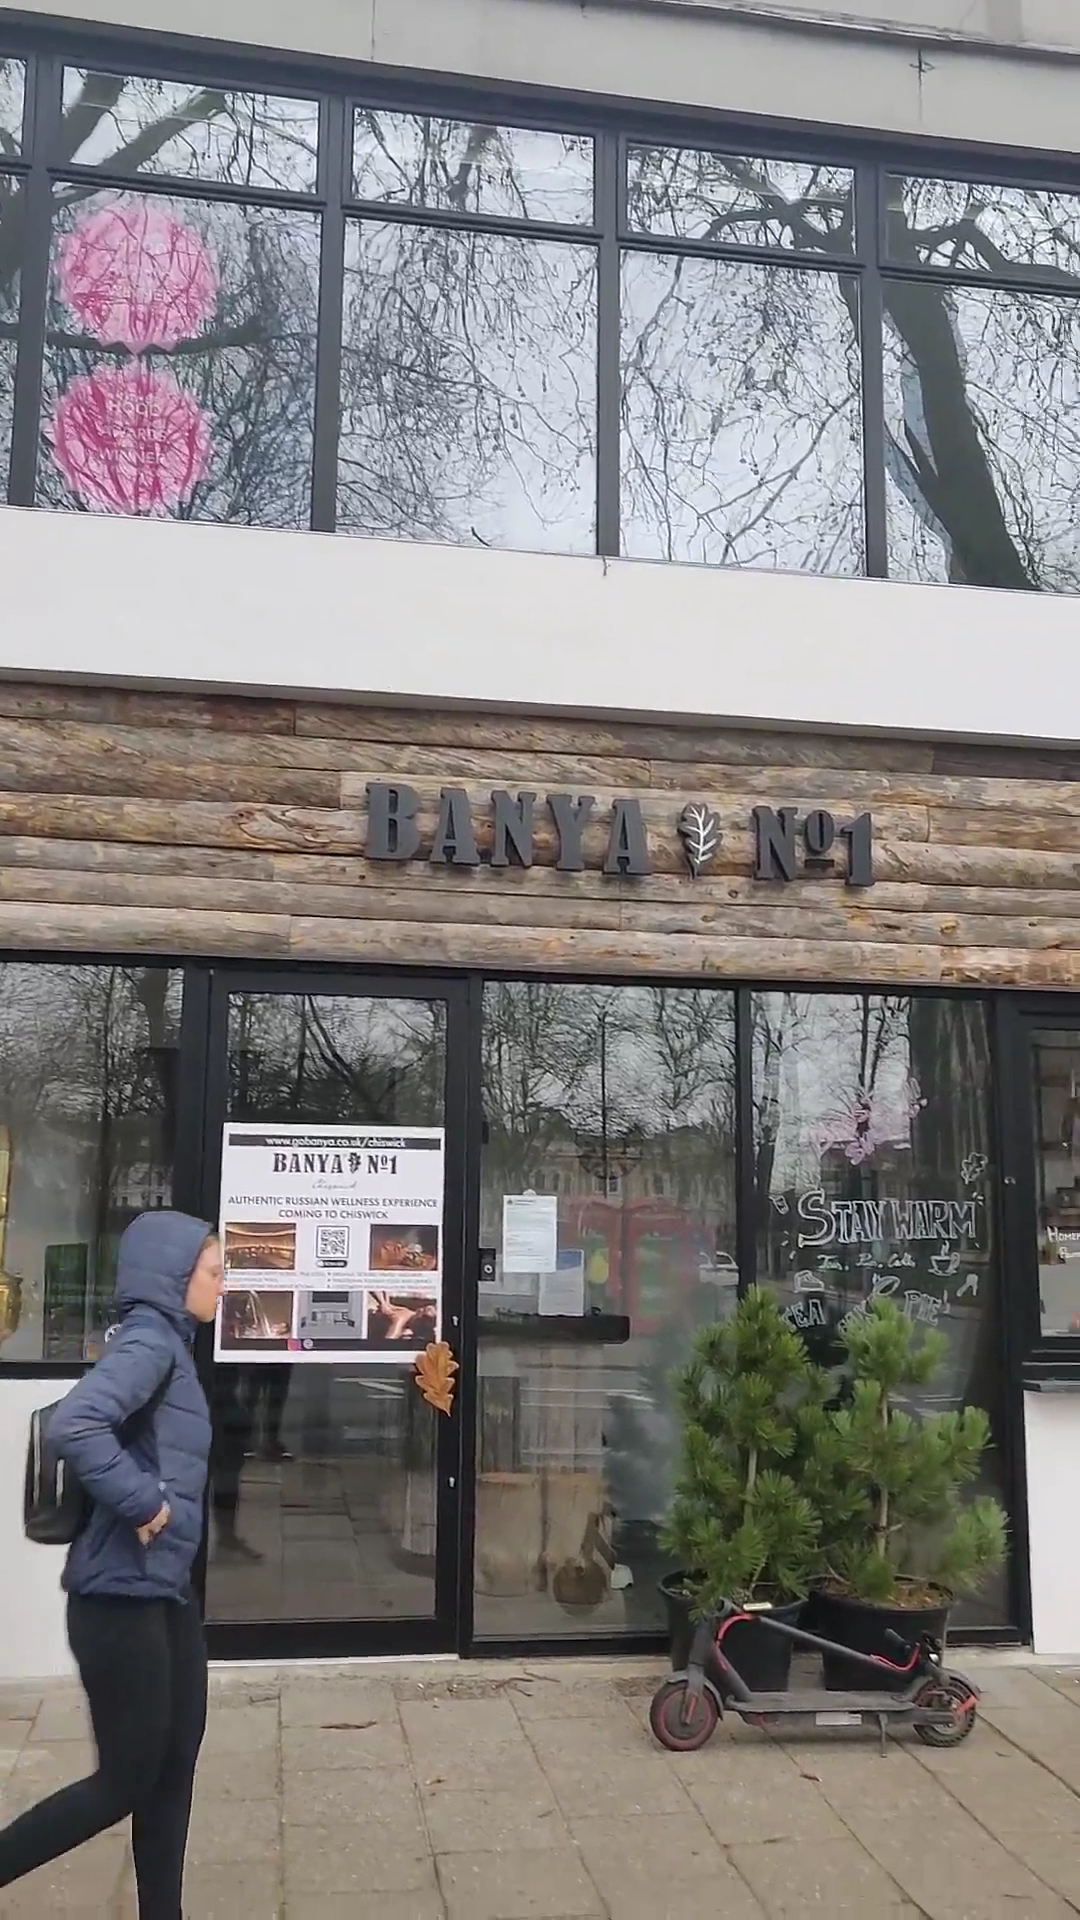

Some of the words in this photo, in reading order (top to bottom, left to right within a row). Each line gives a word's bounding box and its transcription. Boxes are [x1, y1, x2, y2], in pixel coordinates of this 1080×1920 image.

[365, 783, 652, 876] BANYA
[272, 1152, 344, 1174] BANYA
[228, 1196, 283, 1206] AUTHENTIC
[285, 1197, 329, 1206] RUSSIAN
[331, 1198, 380, 1207] WELLNESS
[382, 1198, 438, 1208] EXPERIENCE
[278, 1209, 322, 1219] COMING
[325, 1210, 338, 1219] TO
[339, 1210, 389, 1220] CHISWICK
[798, 1188, 887, 1248] STAY
[891, 1200, 977, 1240] WARM
